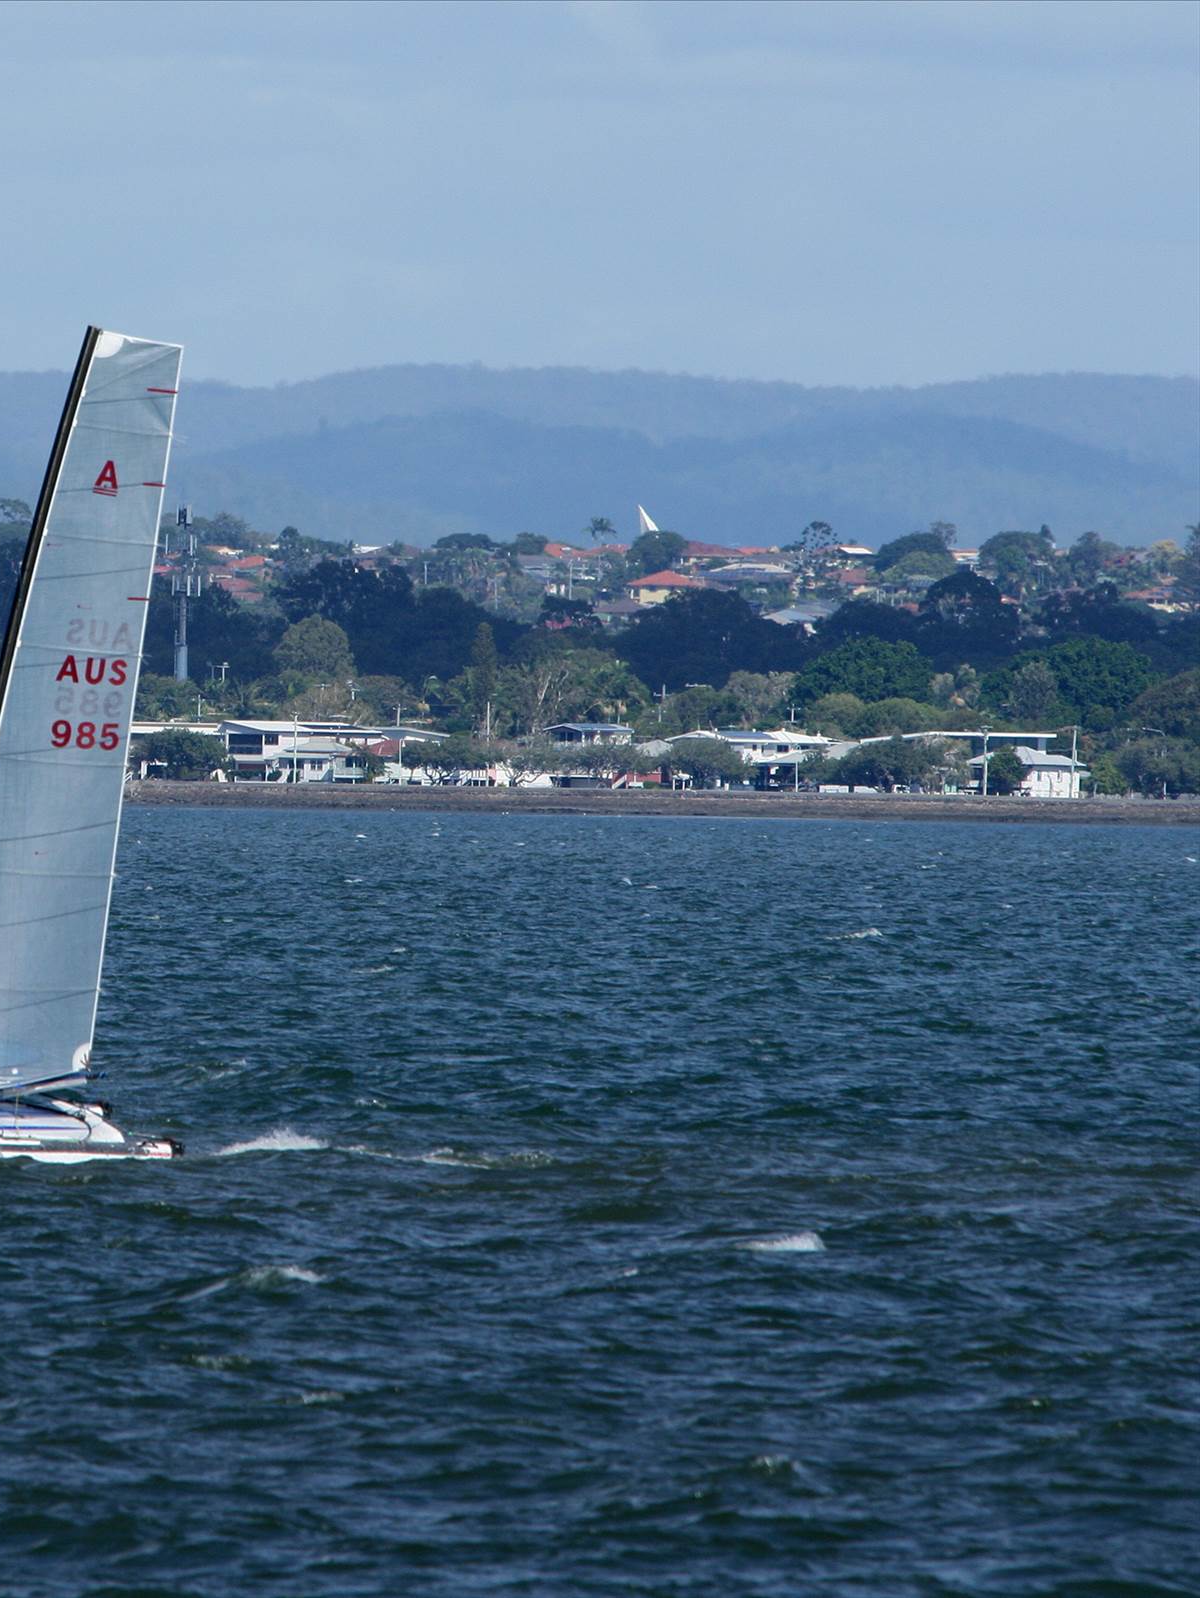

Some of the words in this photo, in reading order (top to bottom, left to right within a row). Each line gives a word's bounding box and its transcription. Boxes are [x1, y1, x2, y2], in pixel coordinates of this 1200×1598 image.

[94, 460, 118, 489] A
[56, 654, 128, 686] AUS
[50, 720, 120, 751] 985
